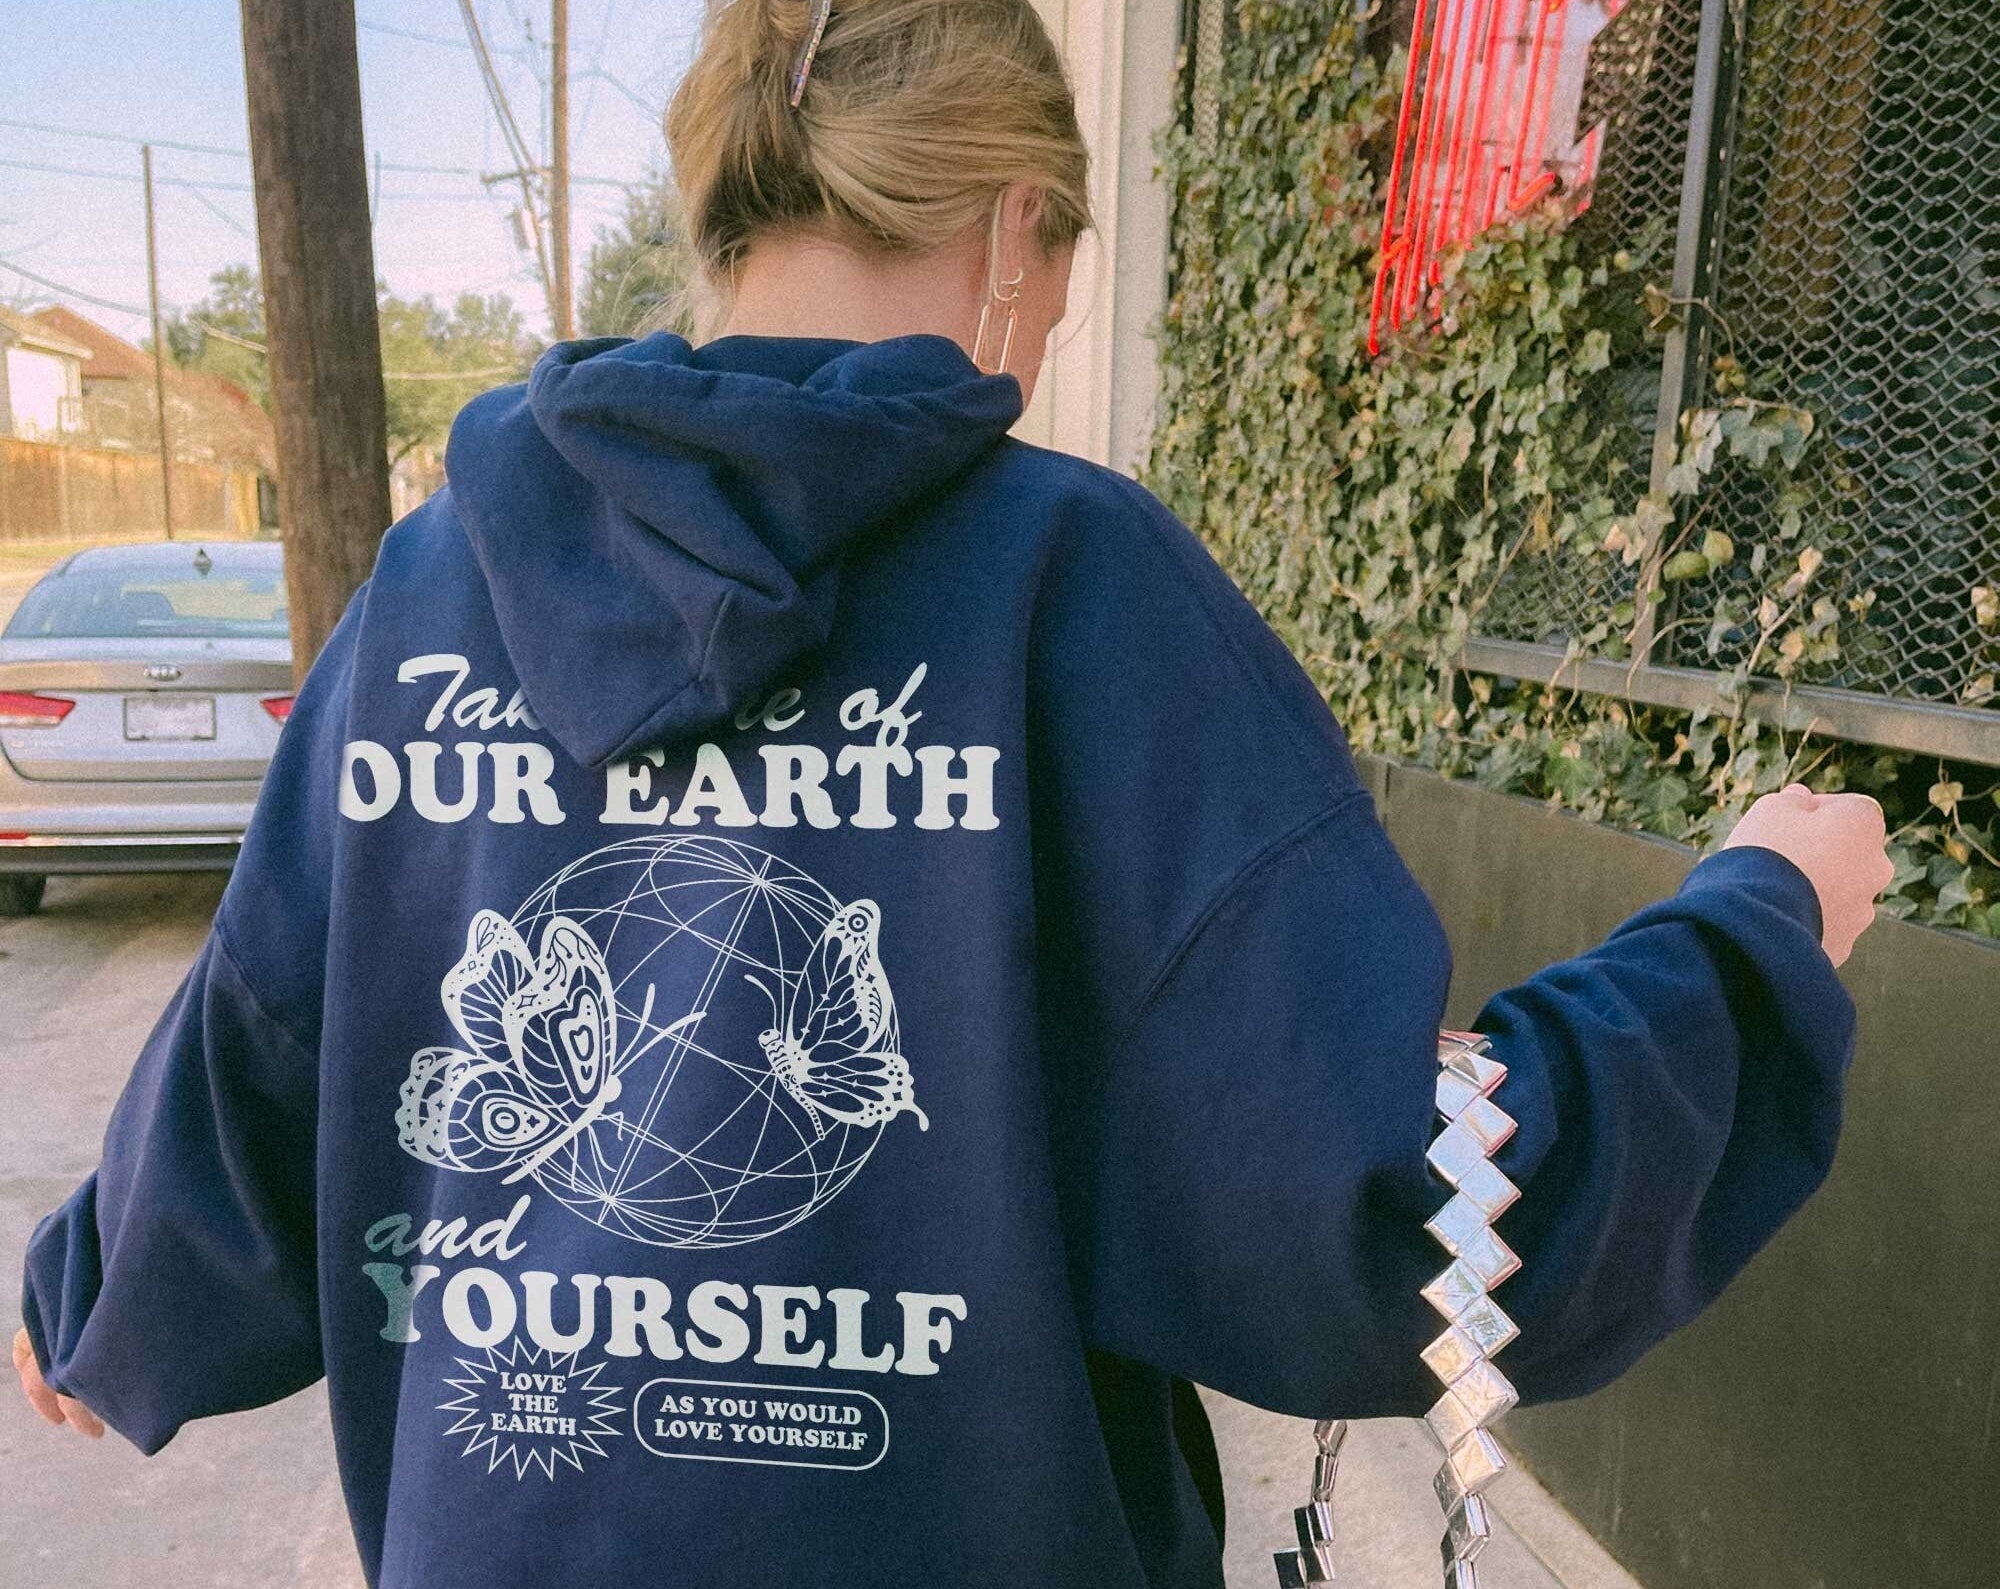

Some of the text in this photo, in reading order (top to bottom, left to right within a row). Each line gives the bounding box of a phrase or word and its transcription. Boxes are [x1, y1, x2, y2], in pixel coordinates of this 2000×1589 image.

[839, 661, 928, 750] of
[338, 740, 1001, 831] OUR EARTH
[364, 1194, 532, 1261] and
[361, 1262, 968, 1376] YOURSELF
[500, 1371, 567, 1394] LOVE
[507, 1393, 559, 1414] THE
[659, 1394, 862, 1426] AS YOU WOULD
[490, 1412, 577, 1437] EARTH
[655, 1418, 868, 1451] LOVE YOURSELF
